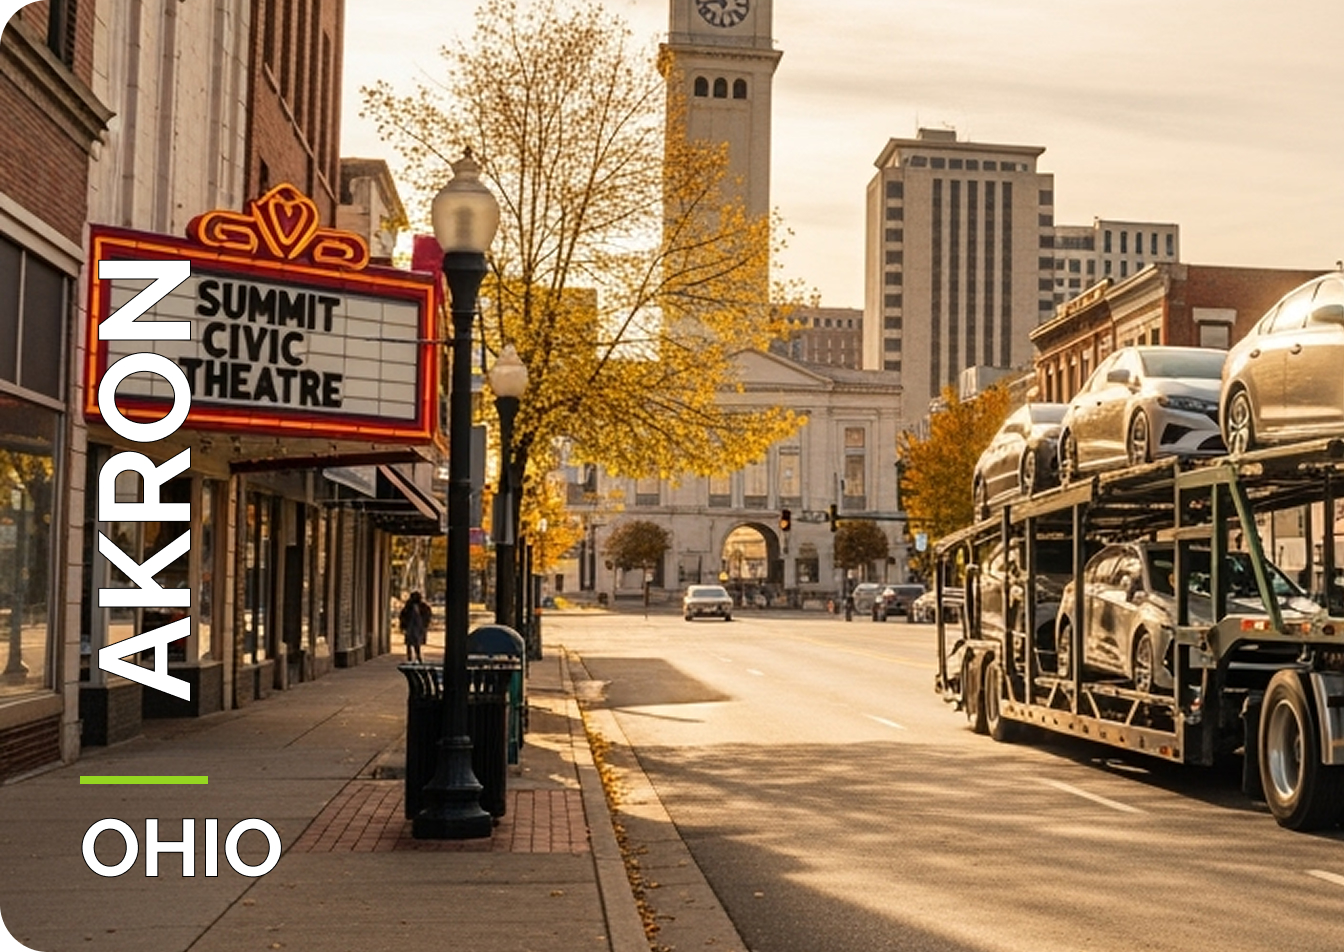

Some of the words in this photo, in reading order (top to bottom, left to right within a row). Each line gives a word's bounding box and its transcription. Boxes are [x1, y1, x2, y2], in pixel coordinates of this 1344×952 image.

[196, 280, 341, 332] SUMMIT
[202, 322, 305, 366] CIVIC
[179, 357, 343, 408] THEATRE
